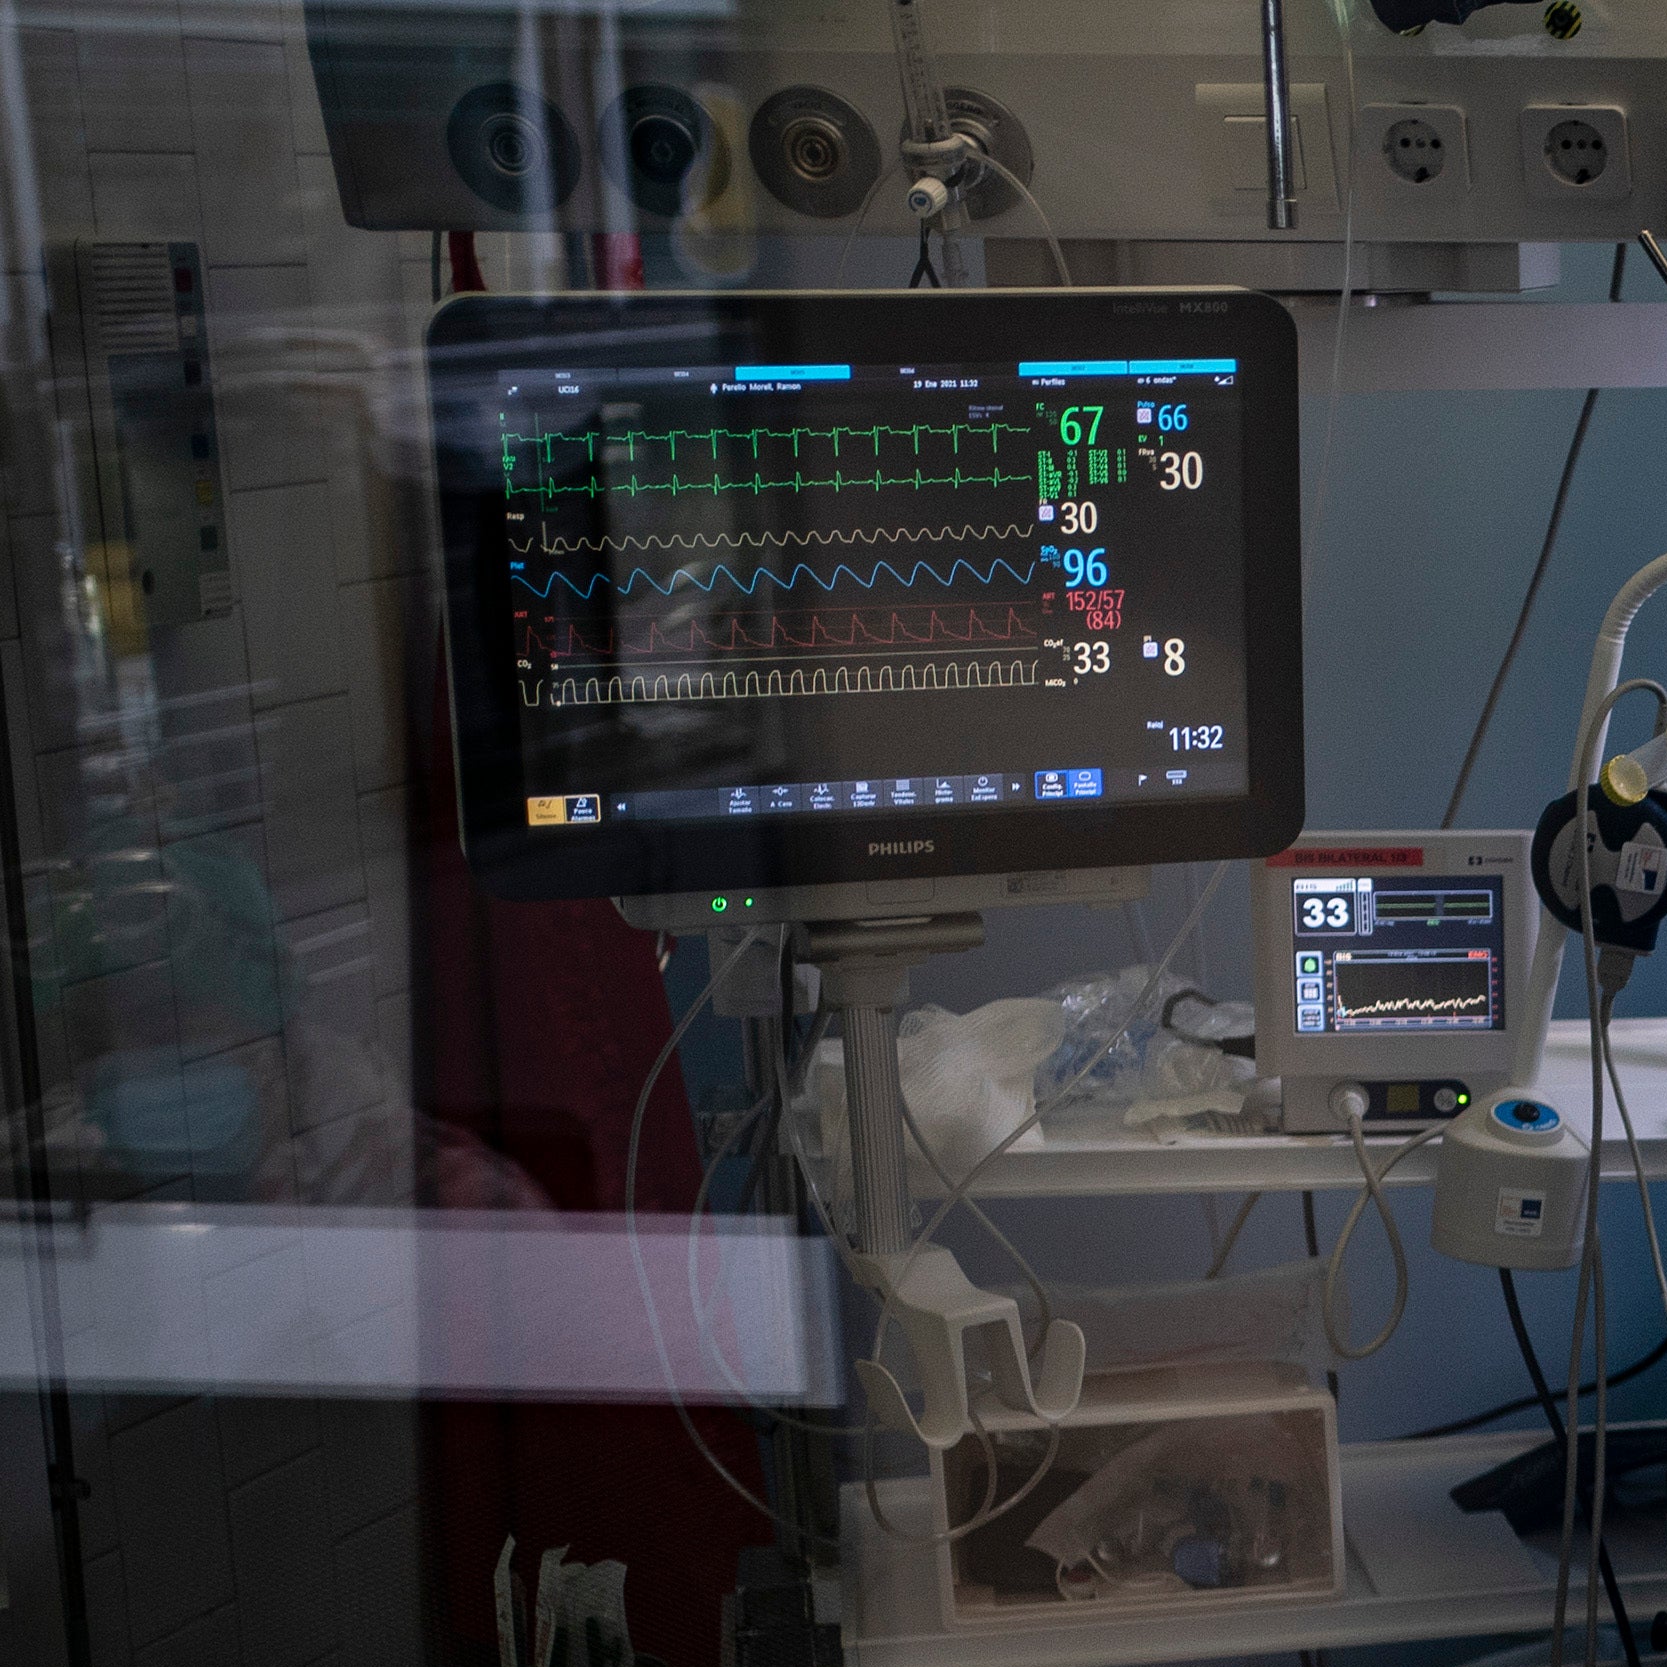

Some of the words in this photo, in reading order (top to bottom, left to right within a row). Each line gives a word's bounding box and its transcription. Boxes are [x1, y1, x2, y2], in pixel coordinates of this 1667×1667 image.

[913, 380, 922, 388] 19
[940, 379, 957, 387] 2021
[1060, 405, 1104, 446] 67
[1158, 403, 1188, 432] 66
[1160, 451, 1203, 490] 30
[1061, 501, 1097, 534] 30
[1063, 547, 1107, 587] 96
[1066, 589, 1125, 611] 152/57
[1086, 610, 1121, 630] (84)
[1073, 641, 1110, 675] 33
[1164, 637, 1185, 676] 8
[1169, 725, 1223, 751] 11:32
[868, 839, 935, 856] PHILIPS
[1302, 897, 1348, 929] 33
